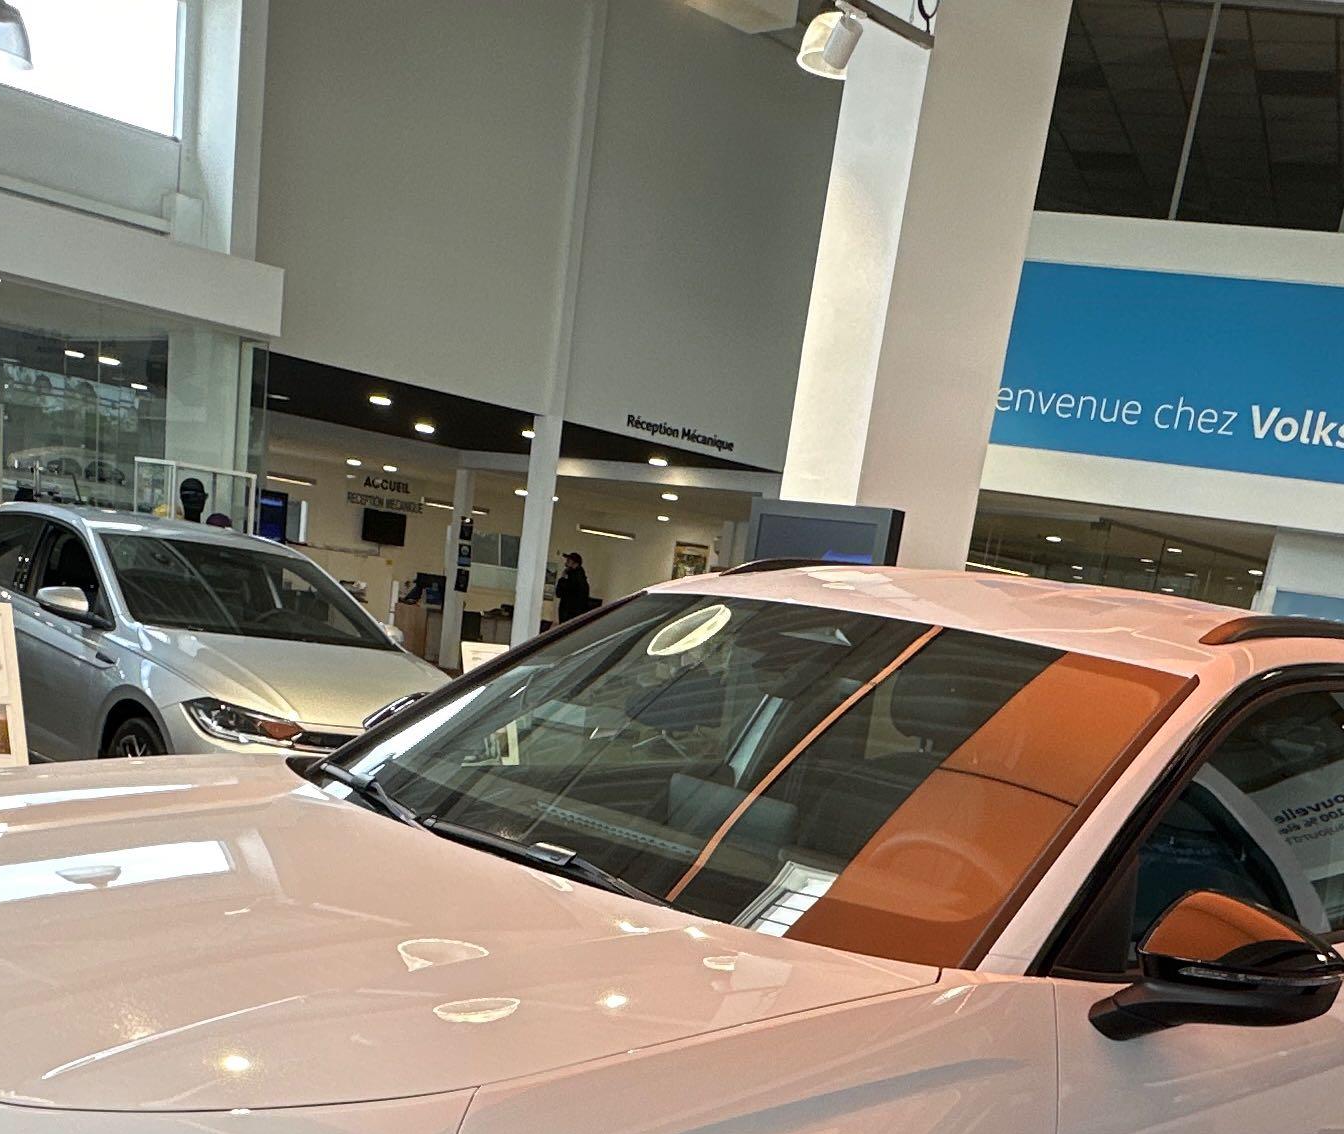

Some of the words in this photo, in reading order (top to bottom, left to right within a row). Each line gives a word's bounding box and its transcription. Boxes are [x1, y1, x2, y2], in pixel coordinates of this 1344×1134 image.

[996, 386, 1142, 425] envenue
[1153, 397, 1239, 435] chez
[626, 414, 679, 438] Réception
[681, 427, 734, 452] Mécanique
[363, 476, 411, 494] ACCUEIL
